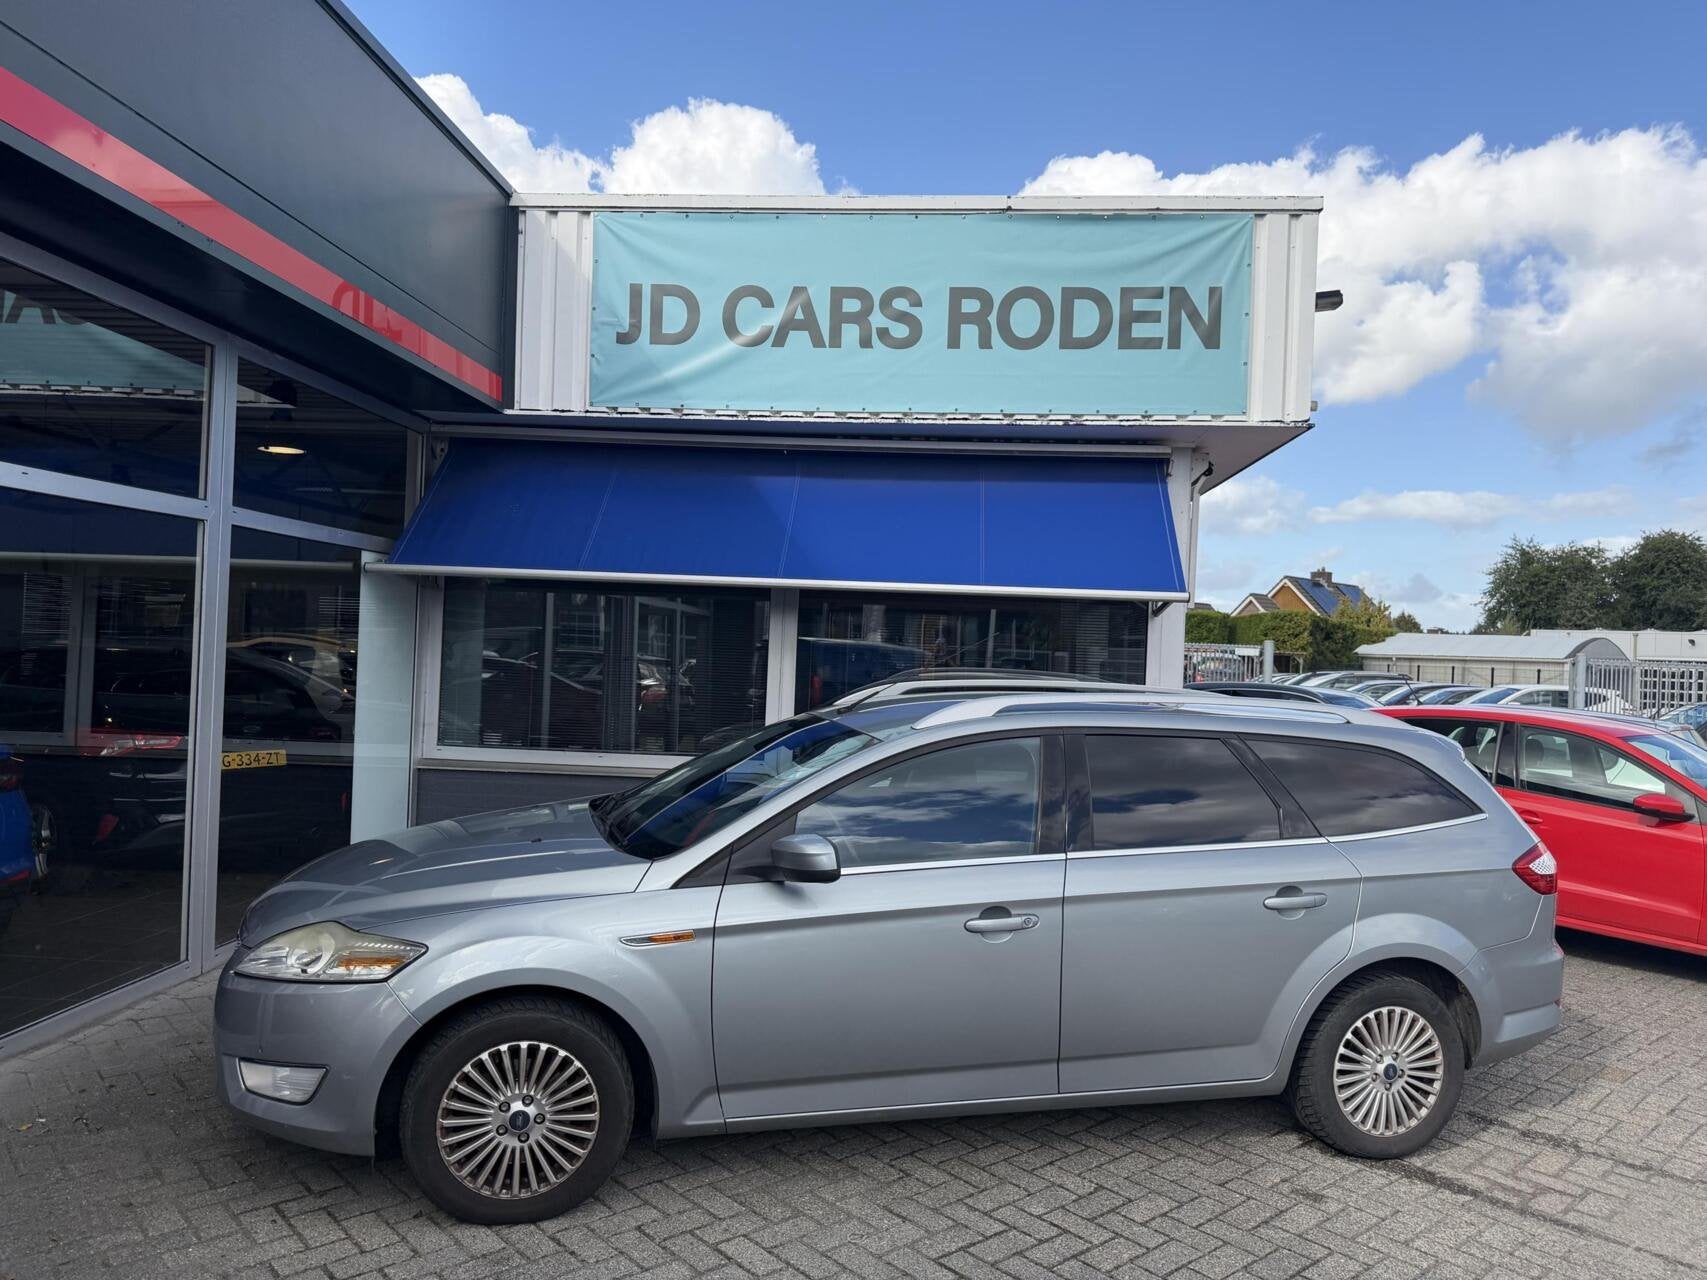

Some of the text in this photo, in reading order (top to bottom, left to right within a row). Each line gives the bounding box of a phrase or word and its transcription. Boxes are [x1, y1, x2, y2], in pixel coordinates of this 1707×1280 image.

[615, 283, 1223, 351] JD CARS RODEN
